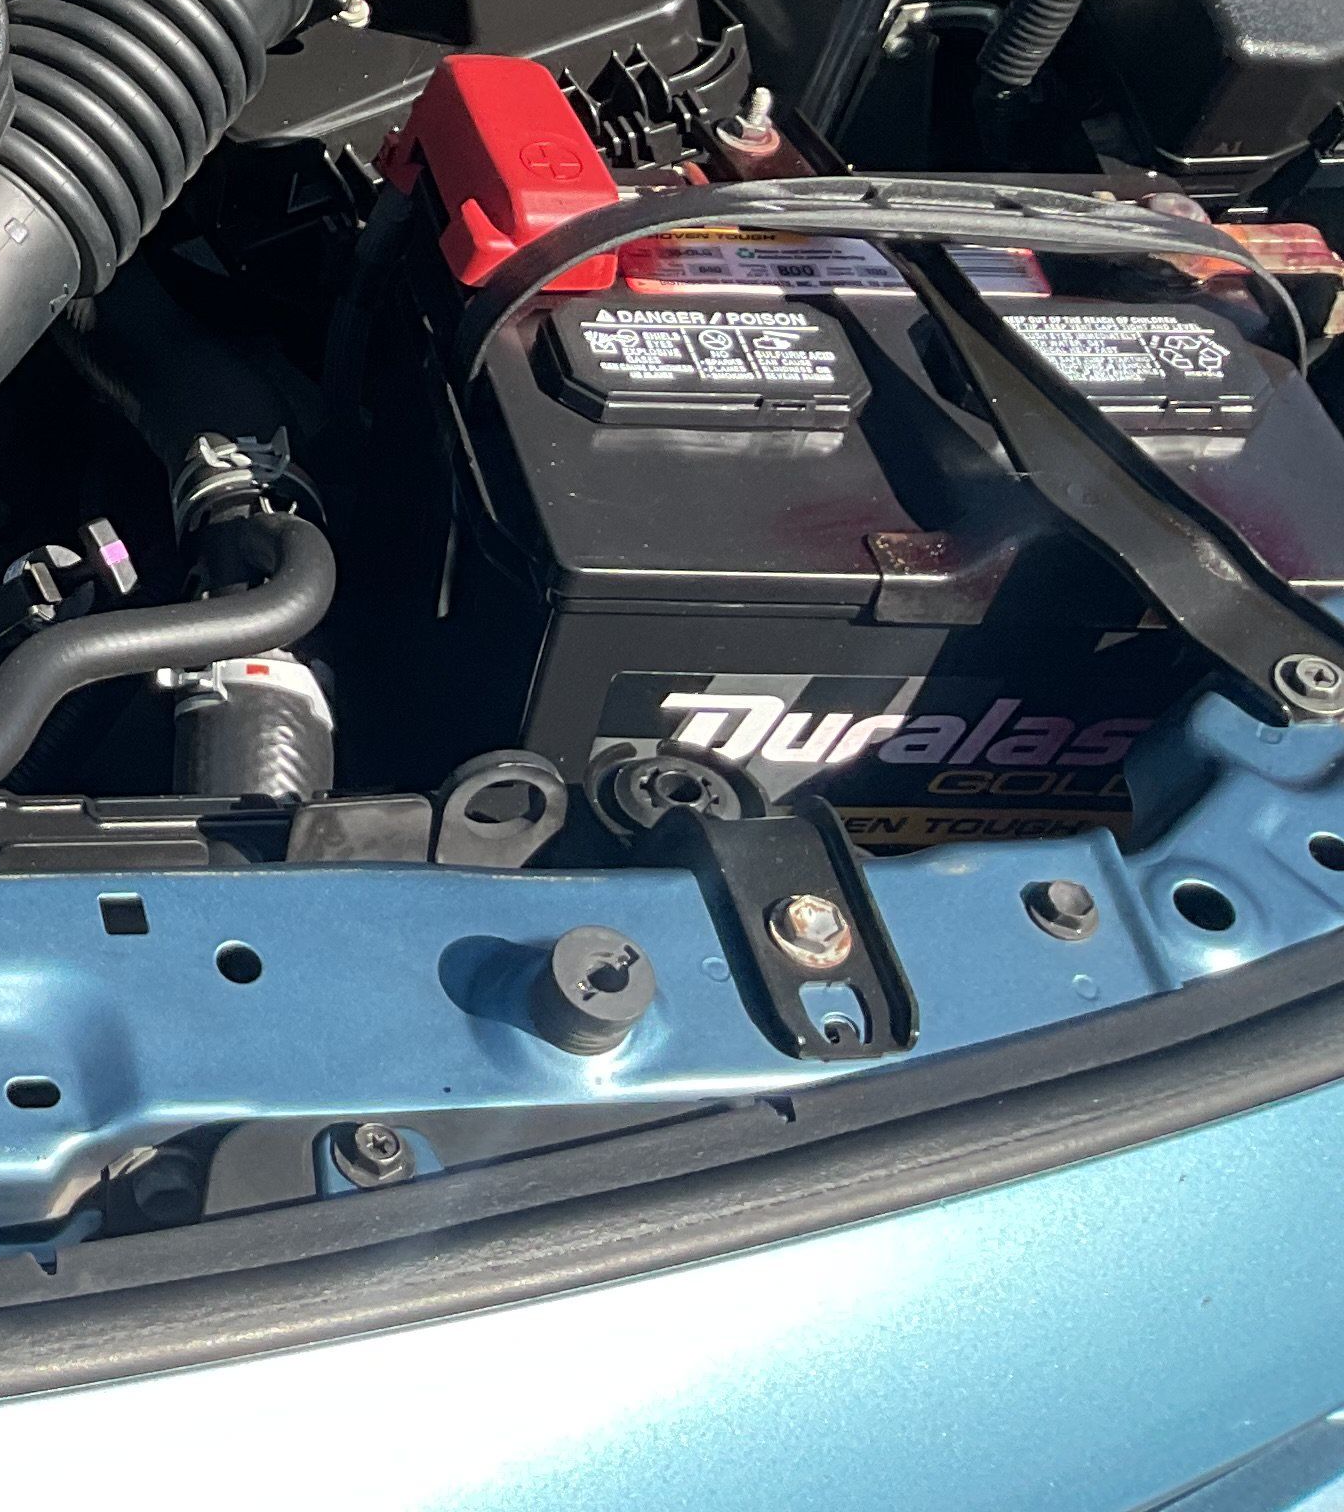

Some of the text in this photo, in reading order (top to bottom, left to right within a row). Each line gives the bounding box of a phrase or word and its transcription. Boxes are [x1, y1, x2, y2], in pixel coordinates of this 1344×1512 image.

[777, 265, 815, 277] 800
[616, 310, 706, 325] DANGER
[725, 312, 808, 326] POISON
[710, 350, 730, 359] NO
[753, 350, 836, 361] SULFURIC ACID
[660, 693, 1154, 765] Duralas
[924, 816, 1092, 835] TOUGH
